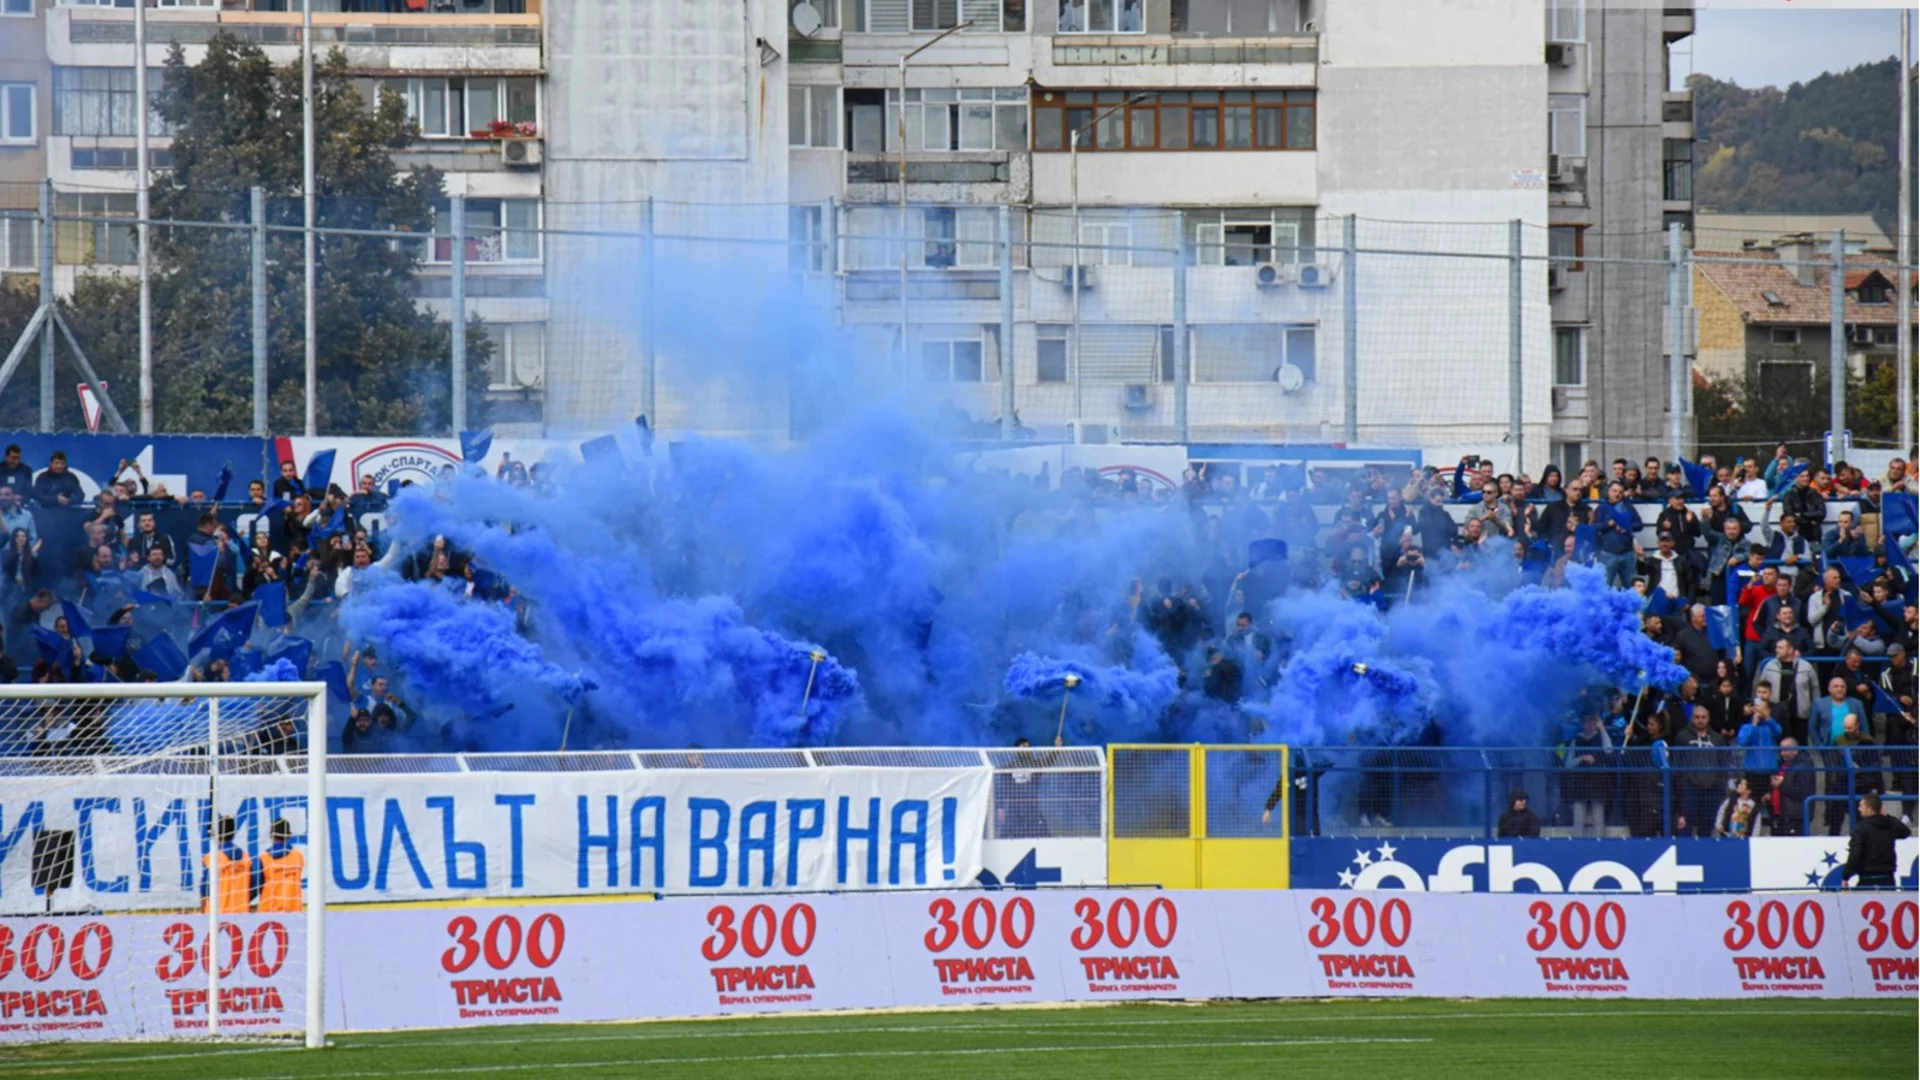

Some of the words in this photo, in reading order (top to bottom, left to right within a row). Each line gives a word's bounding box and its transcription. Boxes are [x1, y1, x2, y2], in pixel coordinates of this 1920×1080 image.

[577, 795, 666, 889] НА
[688, 796, 958, 888] ВАРНА!
[700, 902, 817, 962] 300
[923, 896, 1036, 952] 300
[1070, 896, 1178, 951] 300
[1307, 896, 1412, 948] 300
[1526, 900, 1627, 951] 300
[1723, 899, 1825, 951] 300
[155, 920, 289, 981] 300
[440, 912, 566, 974] 300
[710, 964, 816, 992] ТРИСТА
[933, 956, 1035, 983] ТРИСТА
[1080, 956, 1179, 980] ТРИСТА
[1318, 954, 1415, 978] ТРИСТА
[1536, 957, 1630, 980] ТРИСТА
[1733, 956, 1826, 980] ТРИСТА
[0, 988, 108, 1018] РИСТА
[165, 986, 284, 1016] ТРИСТА
[450, 976, 563, 1006] ТРИСТА
